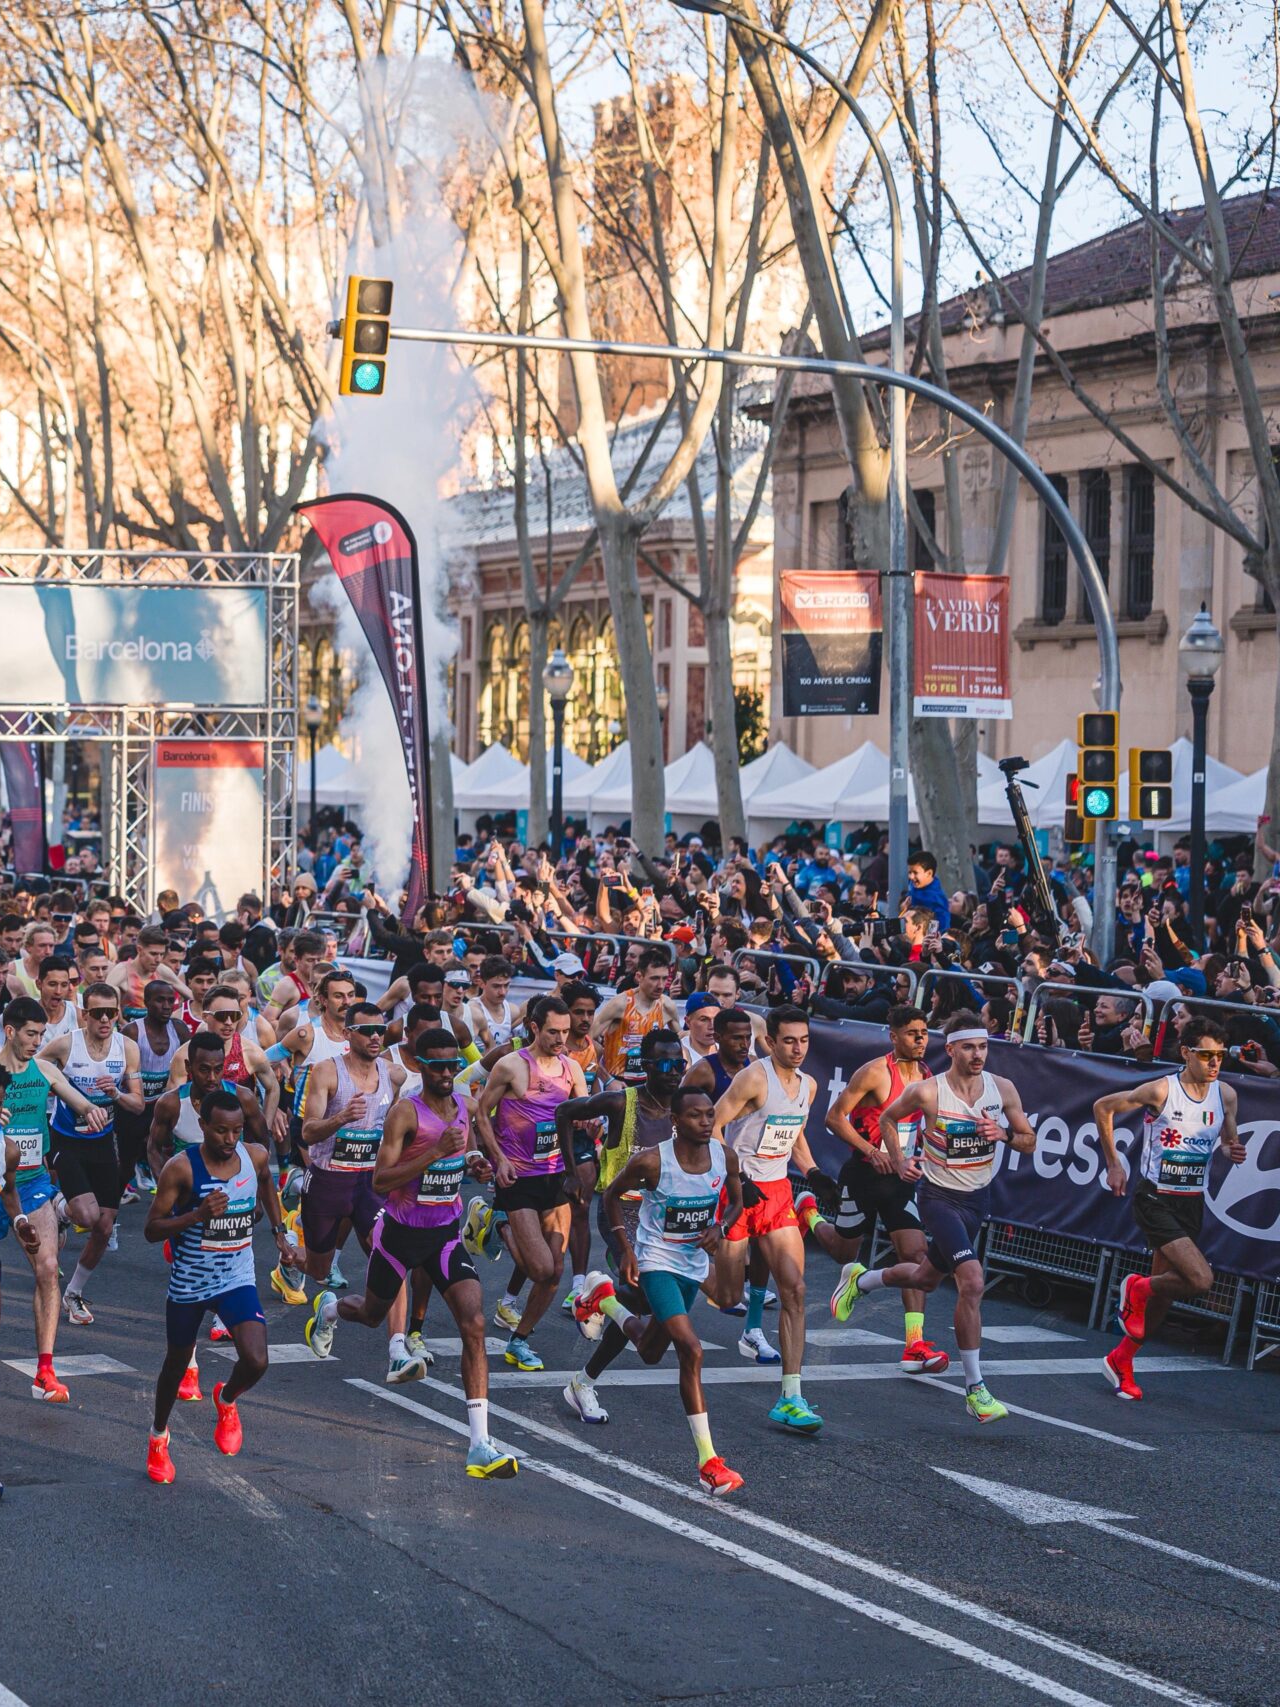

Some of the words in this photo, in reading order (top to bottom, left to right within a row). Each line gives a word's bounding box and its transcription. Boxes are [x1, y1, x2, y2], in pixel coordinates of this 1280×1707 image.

[927, 610, 999, 635] VERDI
[65, 635, 192, 662] Barcelona
[800, 677, 812, 685] 100
[814, 677, 833, 686] ANYS
[834, 676, 844, 684] DE
[845, 676, 872, 685] CINEMA
[925, 683, 938, 693] 10
[940, 683, 958, 693] FEB
[969, 684, 980, 694] 13
[982, 686, 1004, 695] MAR
[163, 750, 211, 763] Barcelona
[345, 1142, 373, 1153] PINTO
[953, 1136, 992, 1149] BEDAR
[970, 1147, 979, 1155] 24
[1161, 1163, 1206, 1176] MONDAZZI
[1180, 1175, 1188, 1183] 22
[443, 1185, 451, 1193] 13
[226, 1202, 250, 1211] YUNDAI
[676, 1209, 710, 1223] PACER
[209, 1214, 253, 1231] MIKIYAS
[689, 1222, 698, 1230] 35
[227, 1229, 237, 1238] 19
